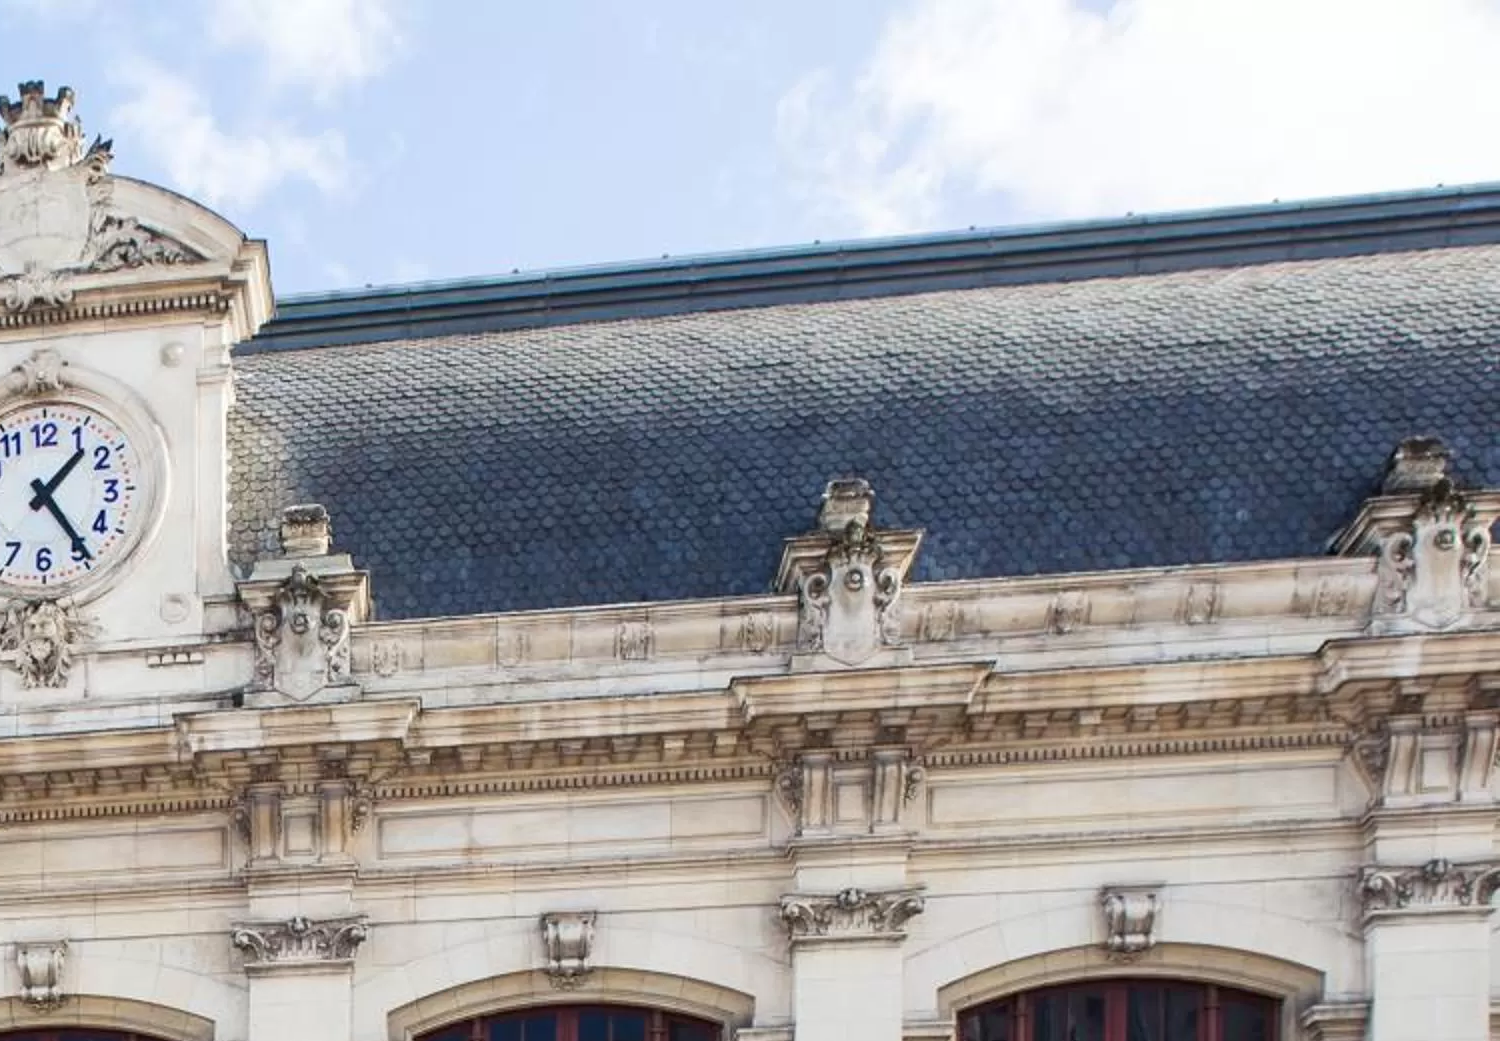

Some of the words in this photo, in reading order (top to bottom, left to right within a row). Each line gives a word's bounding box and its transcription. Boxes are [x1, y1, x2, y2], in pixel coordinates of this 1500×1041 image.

[0, 432, 21, 457] 11
[31, 422, 58, 448] 12
[71, 425, 83, 450] 1
[94, 446, 110, 471] 2
[102, 479, 119, 502] 3
[92, 509, 108, 534] 4
[5, 541, 21, 567] 7
[36, 547, 52, 572] 6
